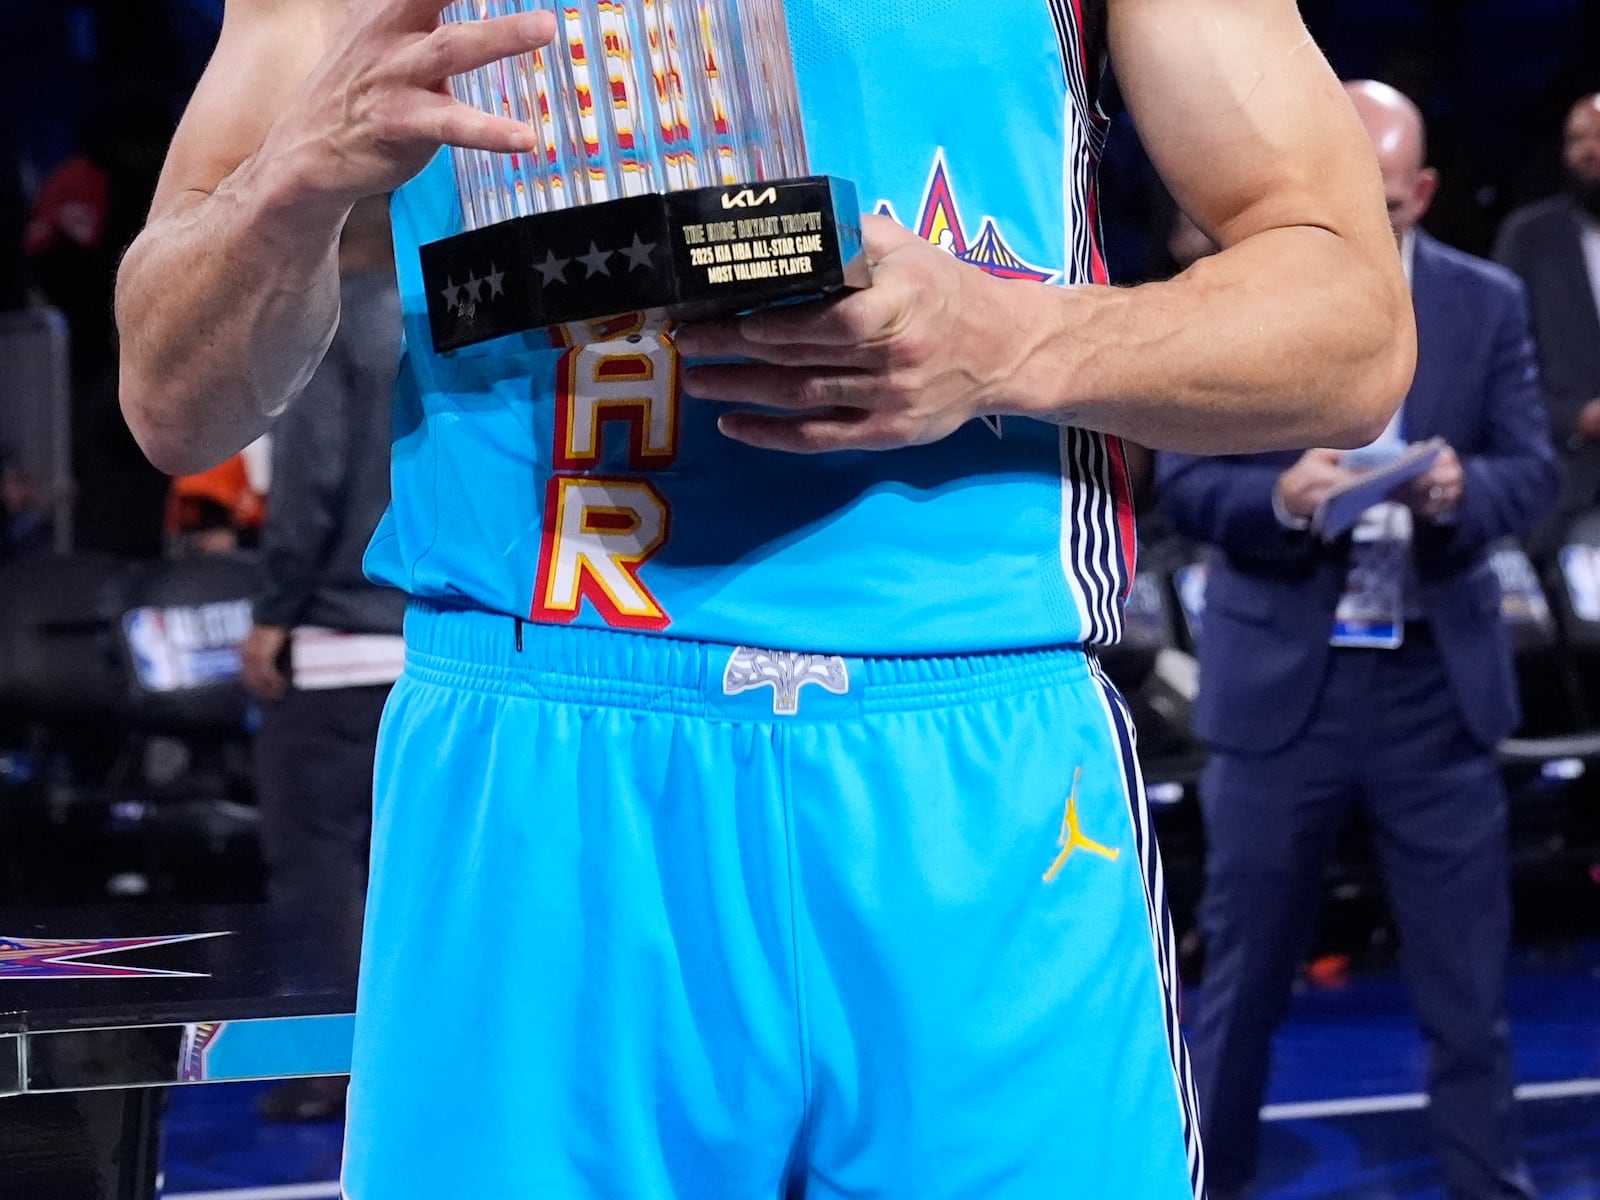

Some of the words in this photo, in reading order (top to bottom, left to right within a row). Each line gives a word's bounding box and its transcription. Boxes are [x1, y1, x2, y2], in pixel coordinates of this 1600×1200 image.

[722, 187, 777, 209] KIA
[683, 225, 705, 244] THE
[781, 213, 821, 232] TROPHY
[691, 247, 714, 265] 2025
[714, 244, 732, 263] KIA
[732, 242, 753, 261] NBA
[753, 238, 795, 257] ALL-STAR
[796, 235, 822, 253] GAME
[709, 265, 732, 284] MOST
[733, 259, 779, 281] VALUABLE
[779, 257, 812, 275] PLAYER
